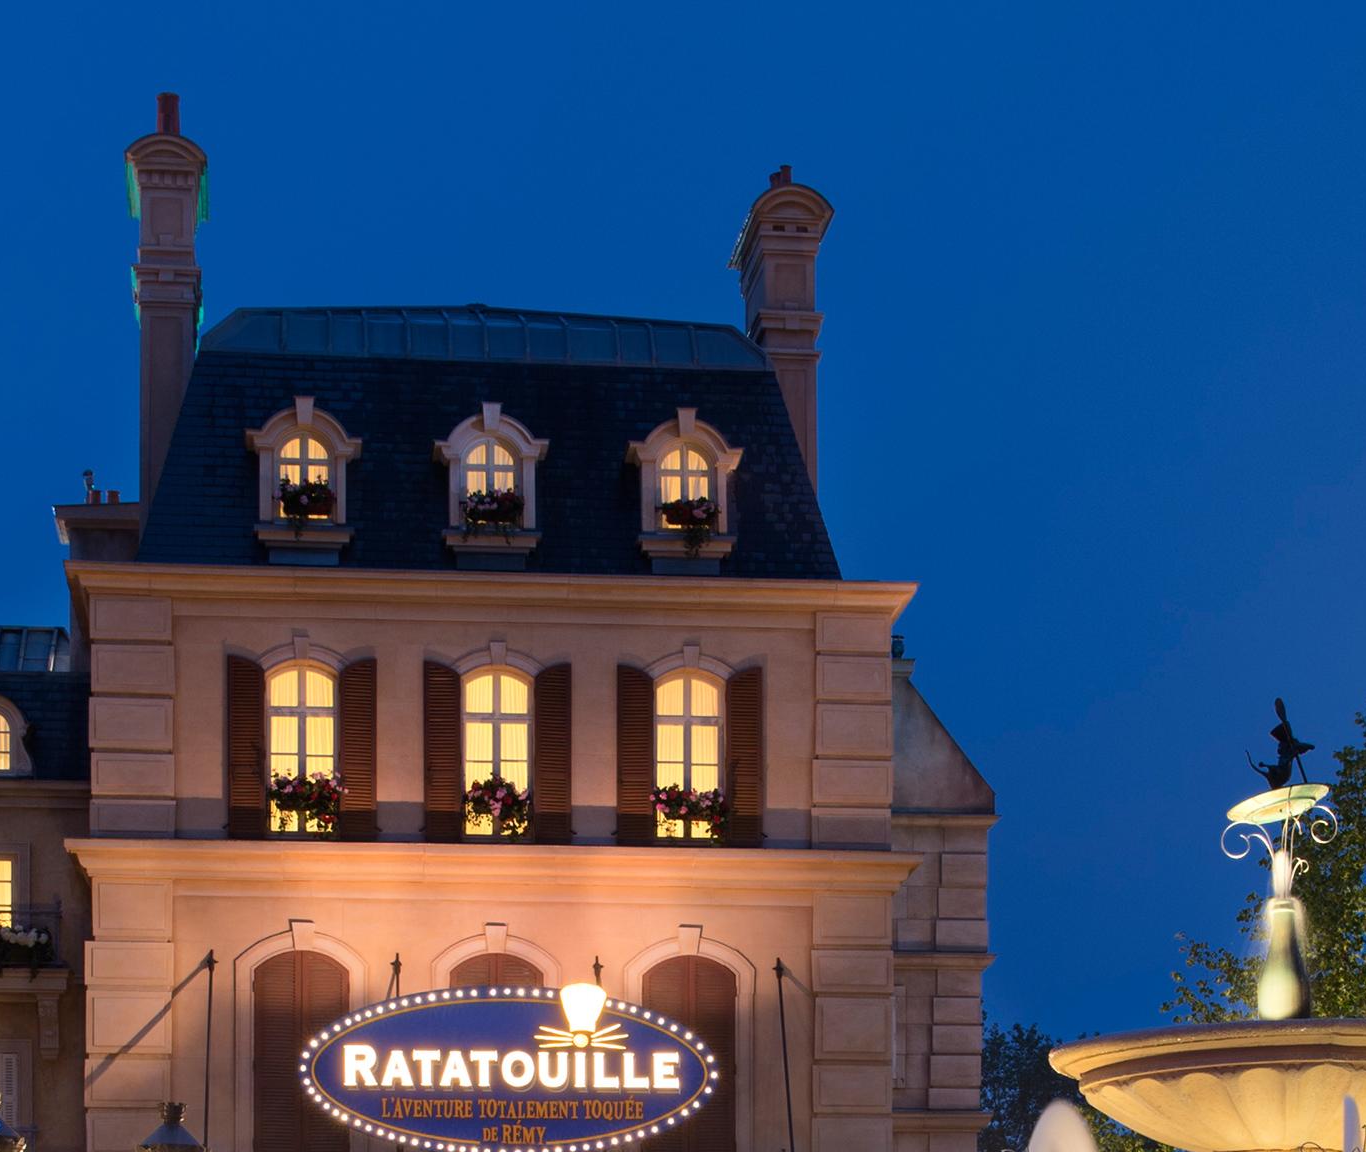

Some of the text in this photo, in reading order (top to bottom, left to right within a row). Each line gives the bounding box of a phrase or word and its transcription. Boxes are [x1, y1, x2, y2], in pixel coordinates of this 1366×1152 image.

[342, 1044, 682, 1093] RATATOUILLE
[381, 1095, 644, 1121] L'AVENTURE TOTALEMENT TOQUÉE
[501, 1119, 547, 1146] RÉMY
